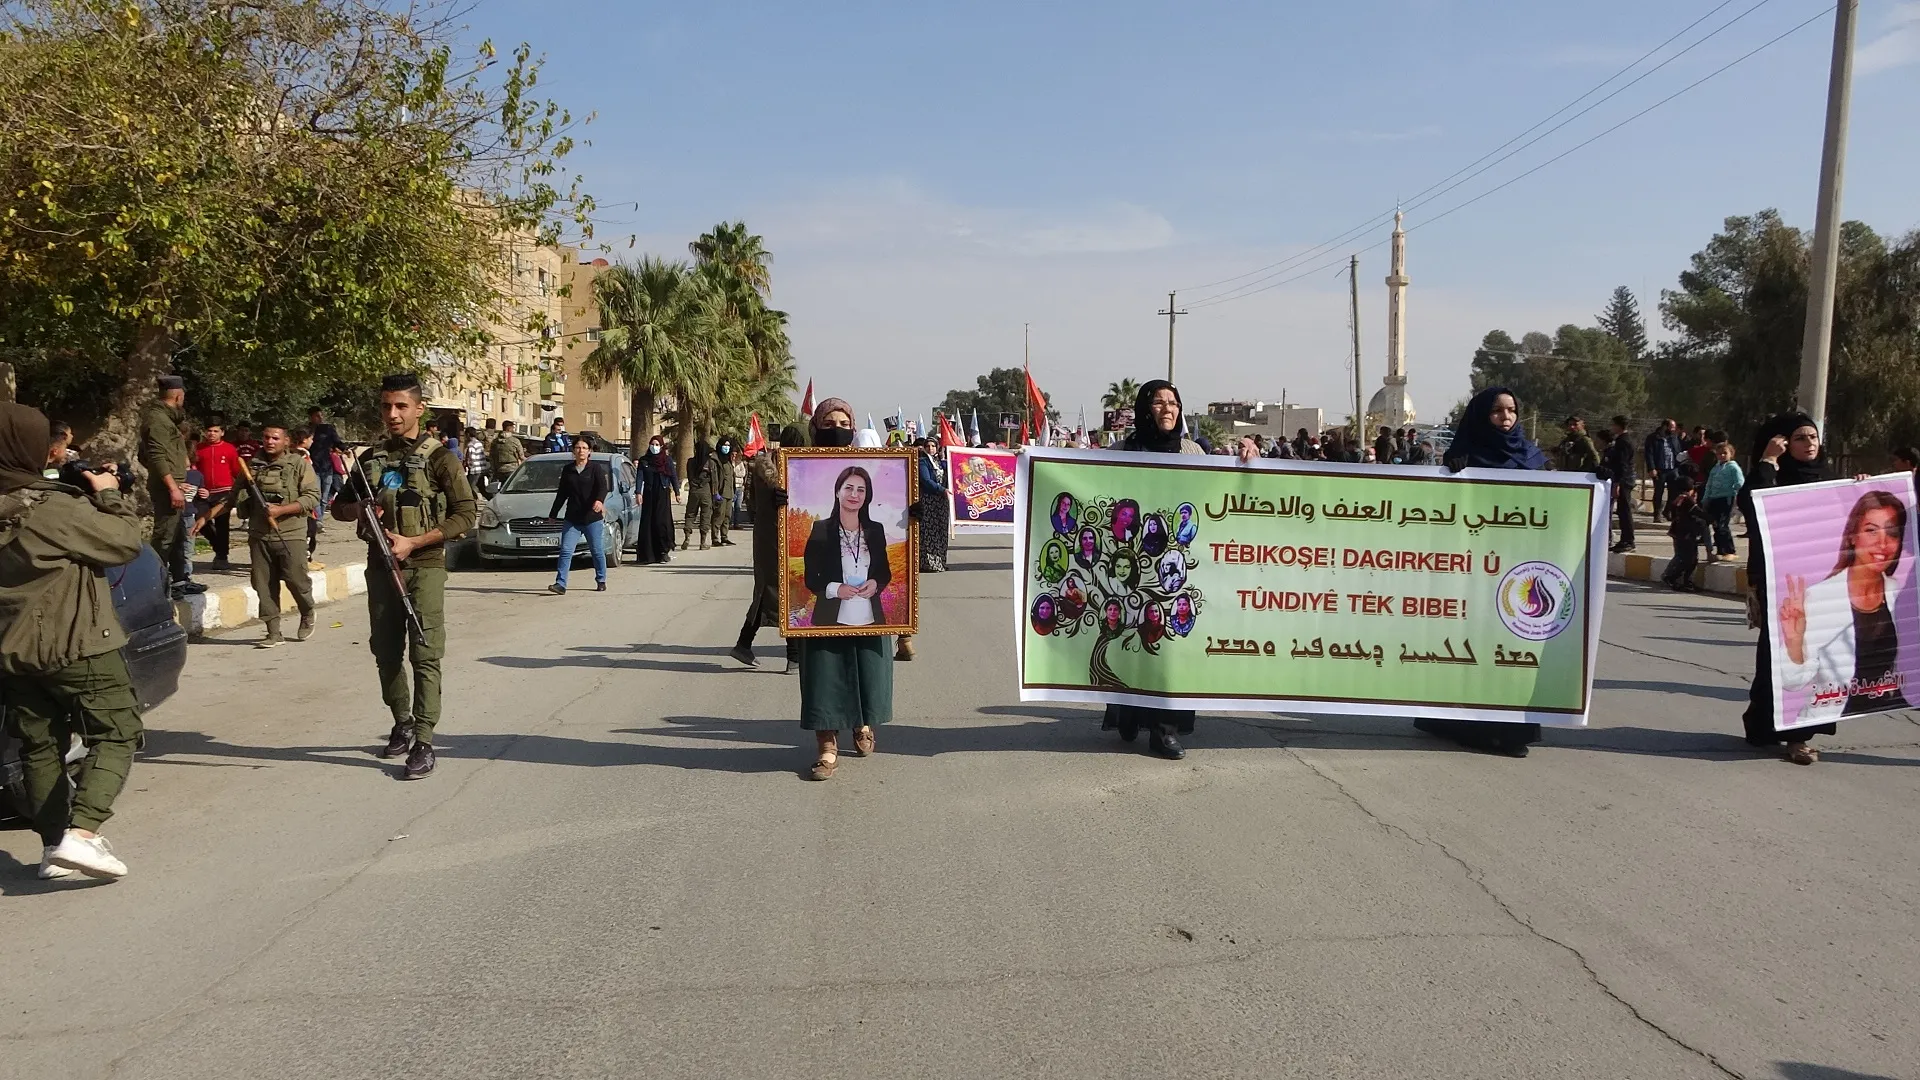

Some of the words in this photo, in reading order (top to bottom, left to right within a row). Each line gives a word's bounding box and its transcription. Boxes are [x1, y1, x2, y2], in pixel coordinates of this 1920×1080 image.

[1204, 493, 1315, 523] والاحتلال
[1322, 498, 1392, 522] العنف
[1398, 503, 1456, 527] لدحر
[1463, 505, 1549, 535] ناضلي
[1343, 548, 1472, 574] DAGIRKERÎ
[1484, 550, 1500, 576] Û
[1237, 586, 1338, 613] TÛNDIYÊ
[1346, 590, 1394, 616] TÊK
[1402, 596, 1467, 619] BIBE!
[1810, 683, 1849, 707] دينيز
[1850, 670, 1904, 698] الشهيدة
